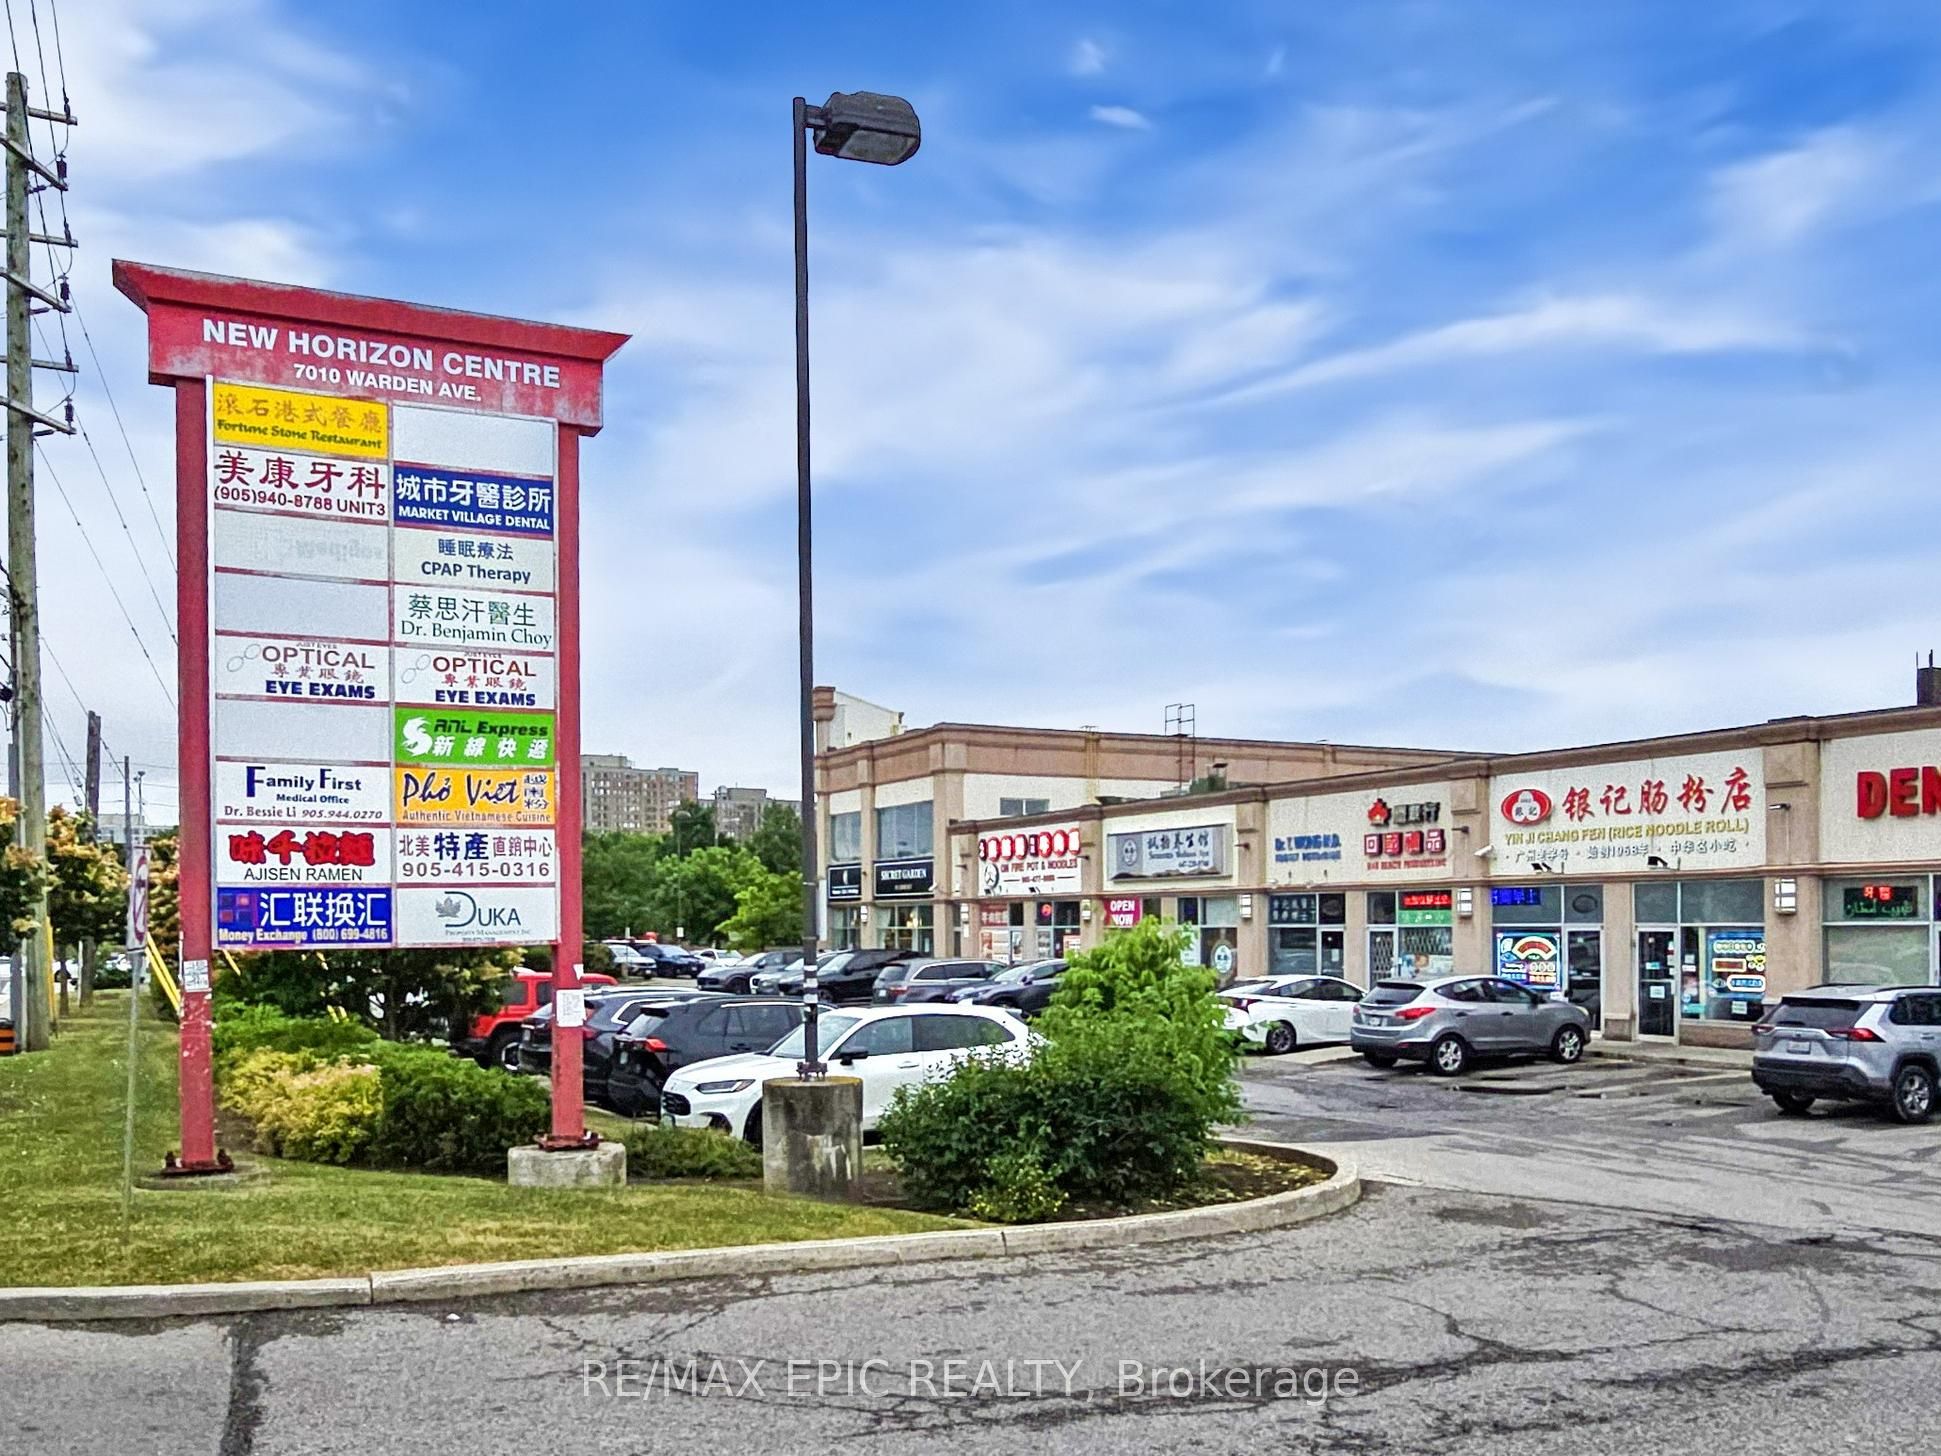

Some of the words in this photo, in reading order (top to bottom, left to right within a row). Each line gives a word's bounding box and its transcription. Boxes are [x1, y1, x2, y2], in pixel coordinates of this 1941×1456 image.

[203, 319, 278, 350] NEW
[288, 330, 433, 371] HORIZON
[443, 353, 560, 388] CENTRE
[293, 364, 340, 383] 7010
[345, 369, 433, 395] WARDEN
[439, 383, 481, 401] AVE.
[217, 419, 267, 435] Fortune
[271, 425, 307, 440] Stone
[311, 430, 382, 449] Restaurant
[214, 450, 386, 499] 美康牙科
[396, 474, 551, 513] 城市牙醫診所
[399, 506, 449, 520] MARKET
[452, 510, 501, 526] VILLAGE
[505, 516, 550, 530] DENTAL
[438, 538, 514, 560] 睡眠療法
[421, 562, 462, 577] CPAP
[467, 564, 531, 584] Therapy
[401, 620, 426, 636] Dr.
[432, 623, 506, 643] Benjamin
[511, 628, 552, 649] Choy
[262, 646, 375, 669] OPTICAL
[433, 656, 536, 677] OPTICAL
[265, 680, 302, 694] EYE
[309, 682, 375, 699] EXAMS
[435, 690, 469, 703] EYE
[475, 691, 536, 706] EXAMS
[477, 721, 548, 737] Express
[246, 766, 314, 798] Family
[320, 768, 362, 791] First
[276, 794, 317, 803] Medical
[319, 795, 350, 804] Office
[1562, 767, 1752, 822] 银记肠粉店
[224, 806, 243, 817] Dr.
[246, 806, 283, 817] Bessie
[286, 807, 296, 817] Li
[402, 811, 450, 820] Authentic
[454, 811, 513, 822] Vietnamese
[515, 812, 551, 822] Cuisine
[1505, 833, 1523, 846] YIN
[1525, 832, 1535, 844] JI
[1538, 830, 1579, 844] CHANG
[1582, 828, 1606, 841] FEN
[1608, 824, 1642, 842] (RICE
[1646, 821, 1702, 837] NOODLE
[1706, 818, 1749, 834] ROLL)
[244, 868, 300, 881] AJISEN
[306, 868, 363, 881] RAMEN
[402, 862, 550, 877] 905-415-0316
[259, 892, 387, 927] 汇联换汇
[445, 891, 521, 928] DUKA
[1110, 900, 1134, 911] OPEN
[1112, 913, 1134, 925] NOW
[218, 928, 253, 943] Money
[256, 928, 307, 943] Exchange
